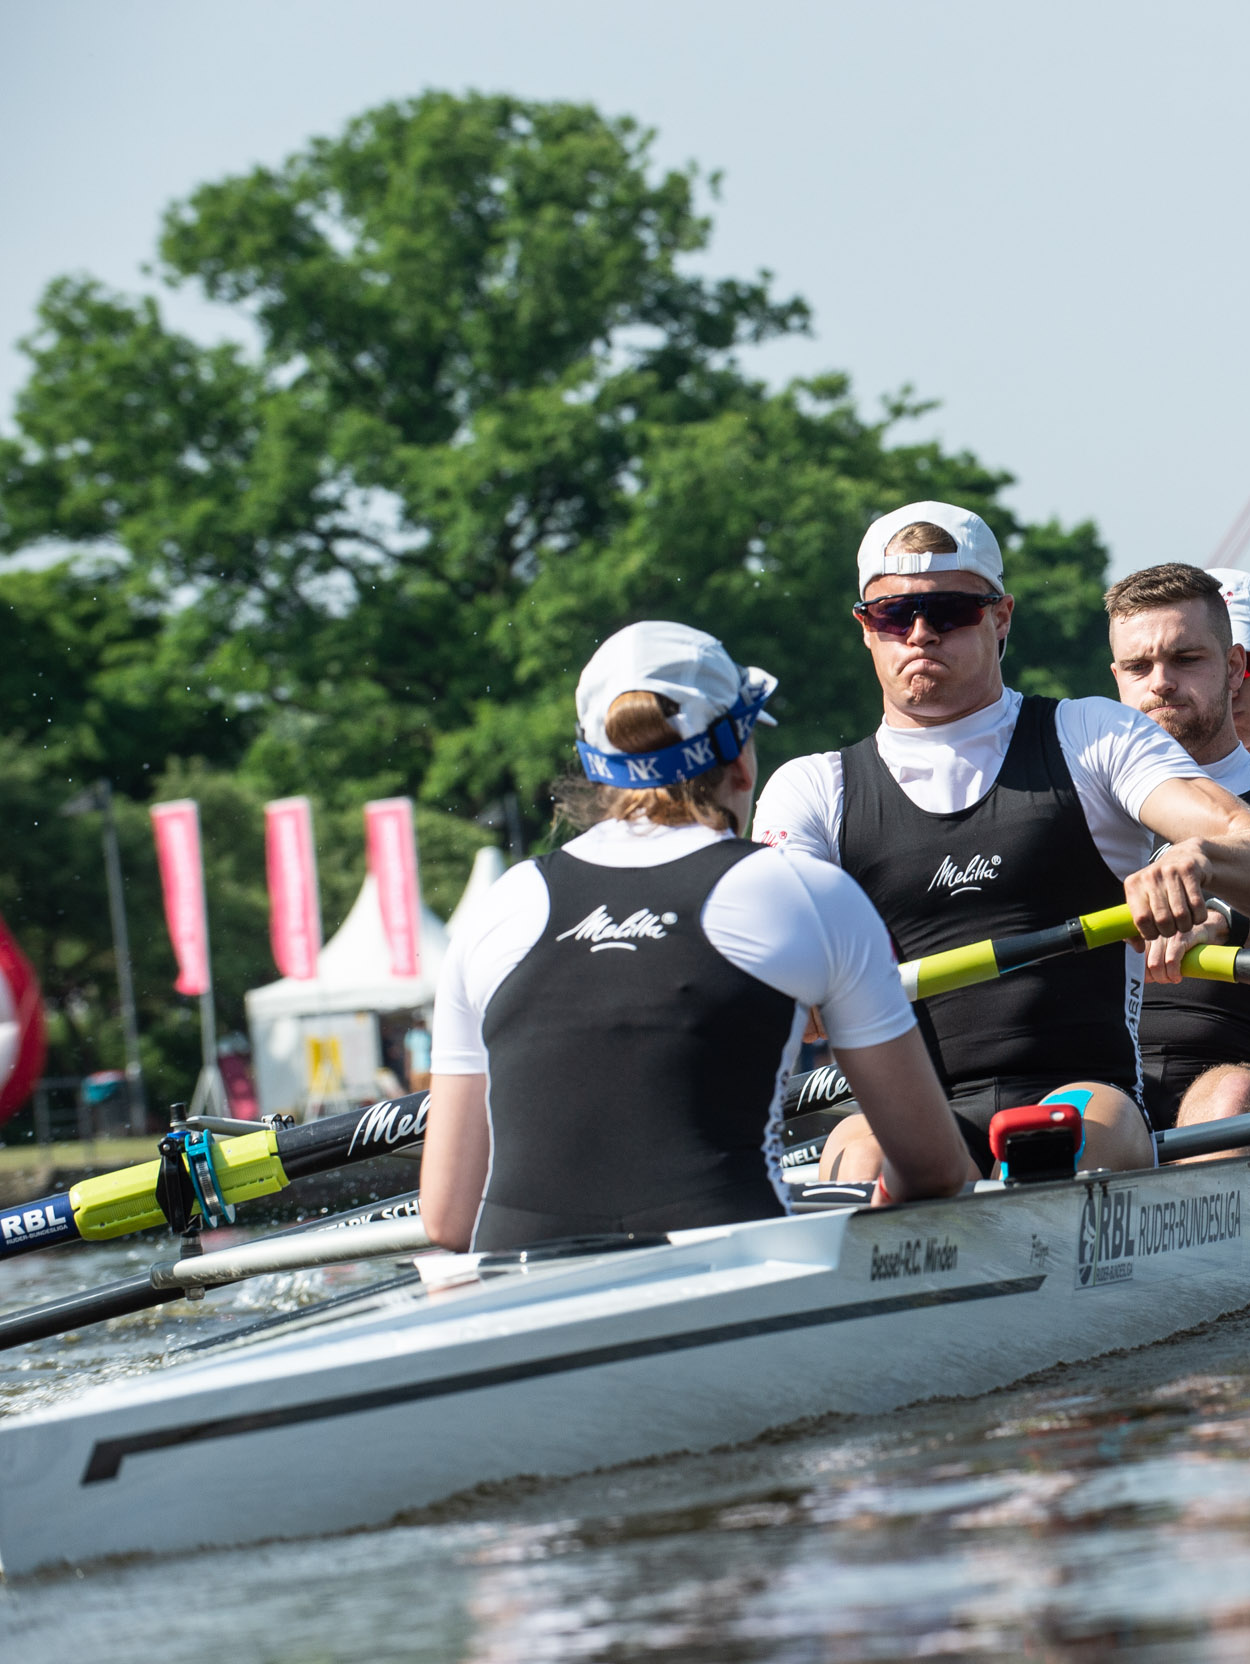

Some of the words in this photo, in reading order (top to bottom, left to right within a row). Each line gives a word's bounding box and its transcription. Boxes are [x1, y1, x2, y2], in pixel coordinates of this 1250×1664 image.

[626, 757, 663, 782] NK
[681, 737, 715, 771] NK
[0, 1205, 66, 1239] RBL
[1098, 1190, 1135, 1262] RBL
[1138, 1189, 1241, 1257] RUDER-BUNDESLIGA
